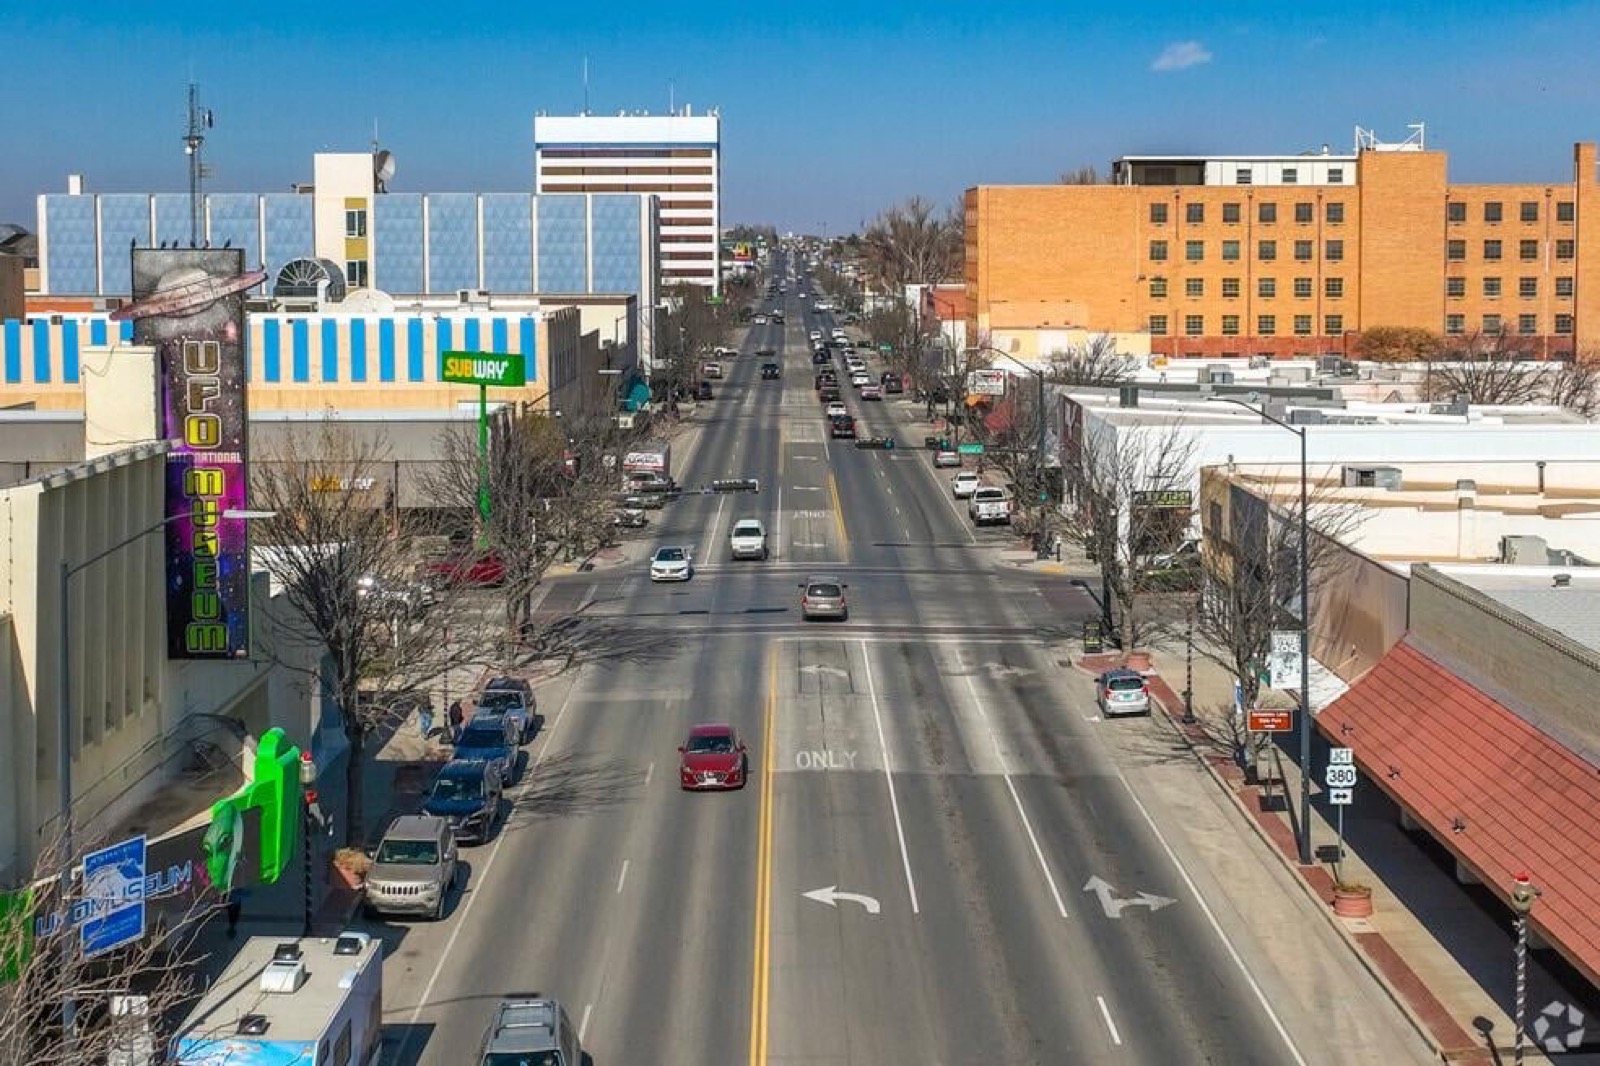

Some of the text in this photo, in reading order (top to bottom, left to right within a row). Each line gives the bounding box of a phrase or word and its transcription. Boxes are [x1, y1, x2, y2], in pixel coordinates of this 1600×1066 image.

[444, 356, 510, 381] SUBWAY
[183, 340, 222, 449] UFO
[182, 468, 230, 654] MUSEUM
[796, 750, 858, 769] ONLY
[1332, 750, 1351, 762] JCT
[1329, 769, 1354, 783] 380
